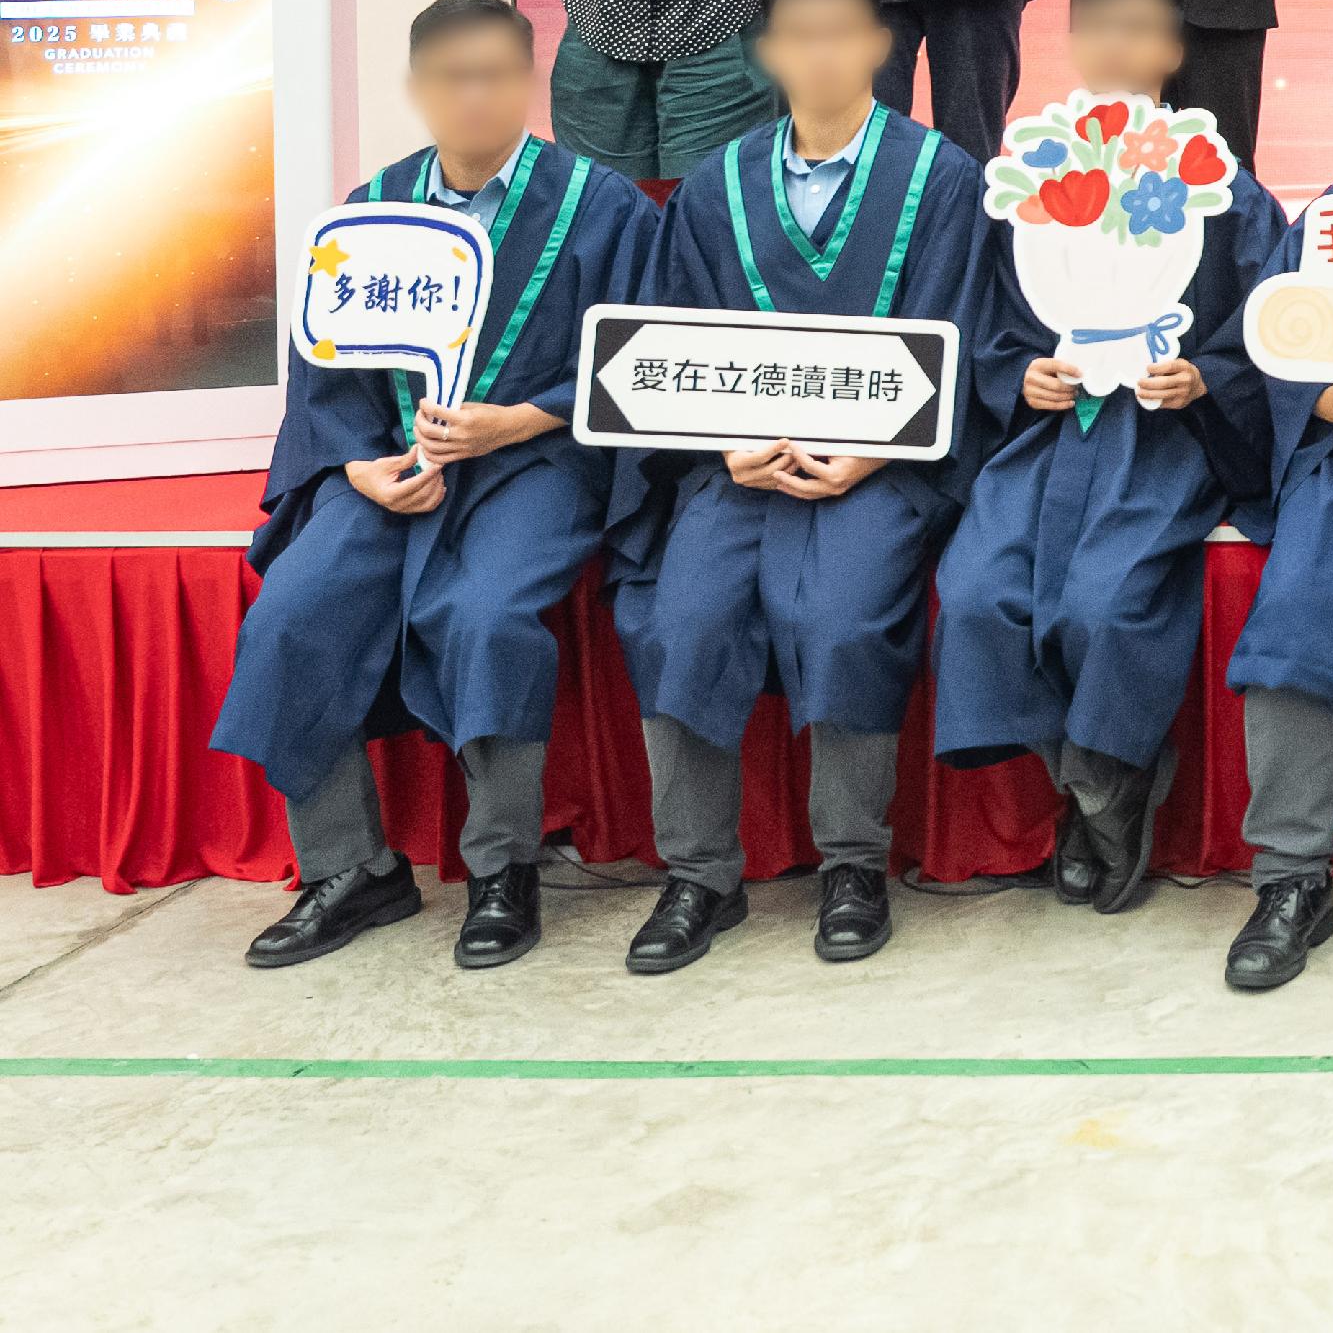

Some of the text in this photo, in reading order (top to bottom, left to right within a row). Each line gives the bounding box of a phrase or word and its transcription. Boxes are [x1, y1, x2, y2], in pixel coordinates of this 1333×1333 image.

[11, 25, 78, 43] 2025
[44, 47, 155, 60] GRADUATION
[328, 272, 461, 313] 多謝你!
[631, 358, 904, 403] 愛在立德讀書時
